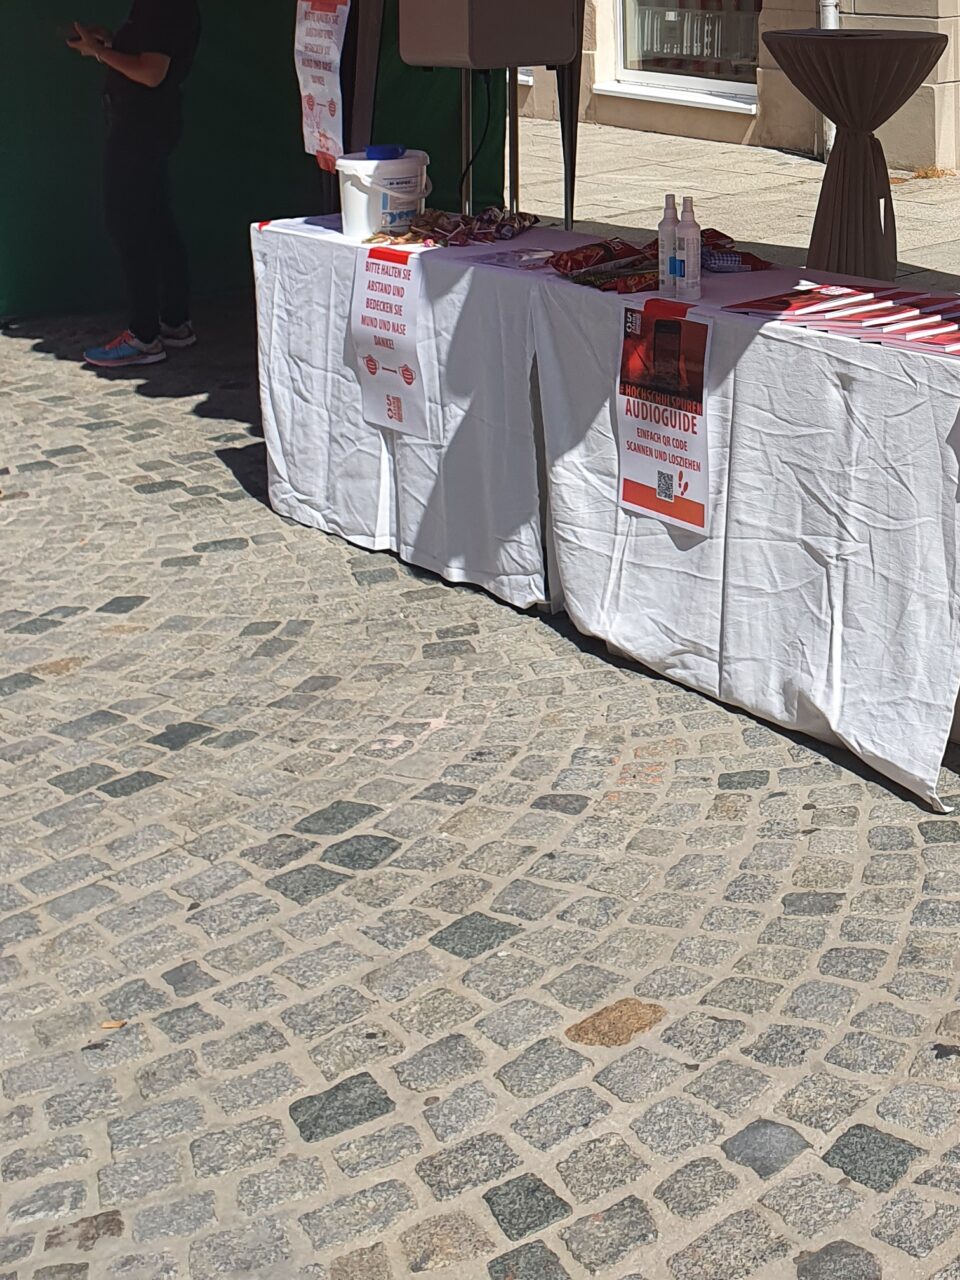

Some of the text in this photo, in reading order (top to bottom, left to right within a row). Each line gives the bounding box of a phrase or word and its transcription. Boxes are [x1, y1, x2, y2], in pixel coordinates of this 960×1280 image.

[365, 261, 412, 280] BITTE HALTEN SIE
[367, 280, 405, 298] ABSTAND UND
[365, 297, 403, 316] BEDECKEN SIE
[361, 314, 407, 335] MUND UND NASE
[625, 398, 698, 435] AUDIOGUIDE
[636, 427, 688, 452] EINFACH QR CODE
[626, 440, 701, 472] SCANNEN UND LOSZIEHEN
